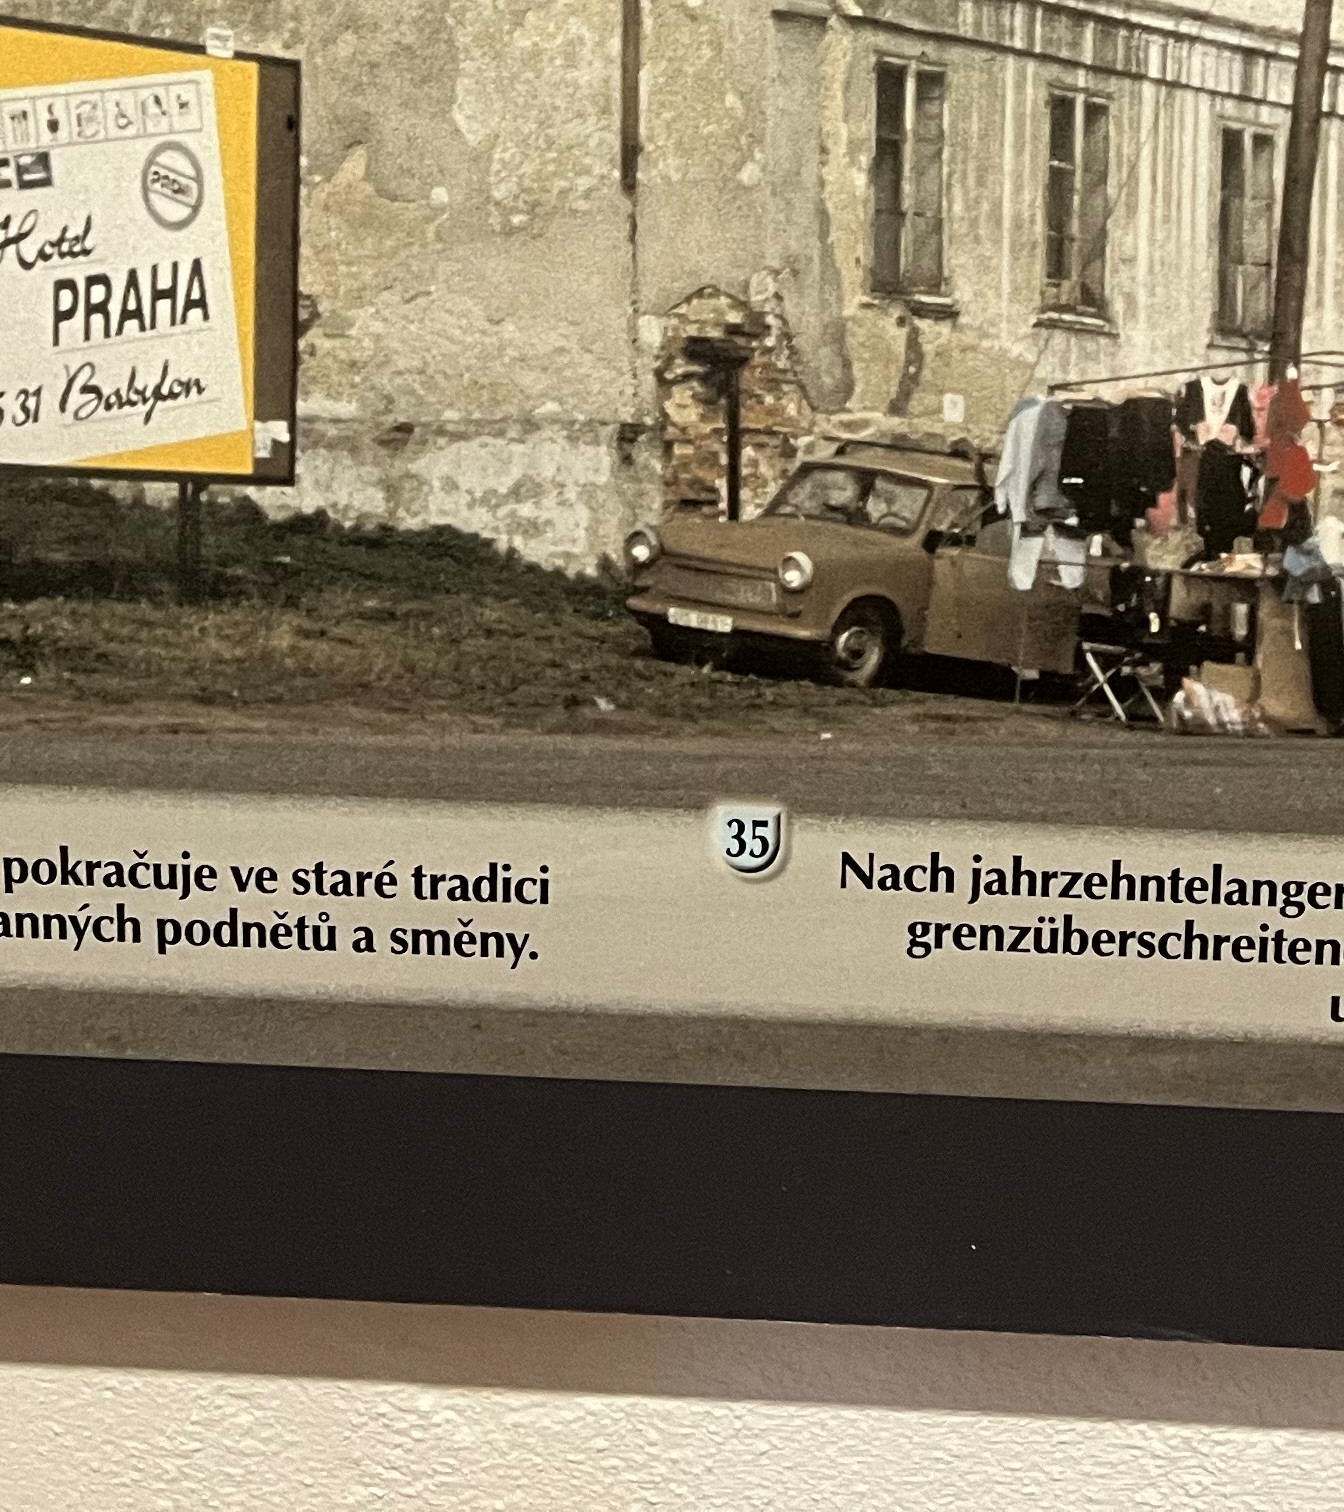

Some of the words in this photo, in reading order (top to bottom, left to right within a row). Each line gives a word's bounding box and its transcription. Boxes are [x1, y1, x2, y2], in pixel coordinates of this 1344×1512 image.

[52, 257, 210, 347] PRAHA
[59, 359, 206, 425] Babylon
[725, 818, 770, 859] 35
[2, 845, 218, 900] pokračuje
[230, 866, 278, 894] ve
[292, 859, 398, 899] staré
[411, 862, 549, 905] tradici
[840, 851, 955, 893] Nach
[156, 907, 337, 955] podnětů
[352, 926, 377, 953] a
[390, 918, 539, 970] směny.
